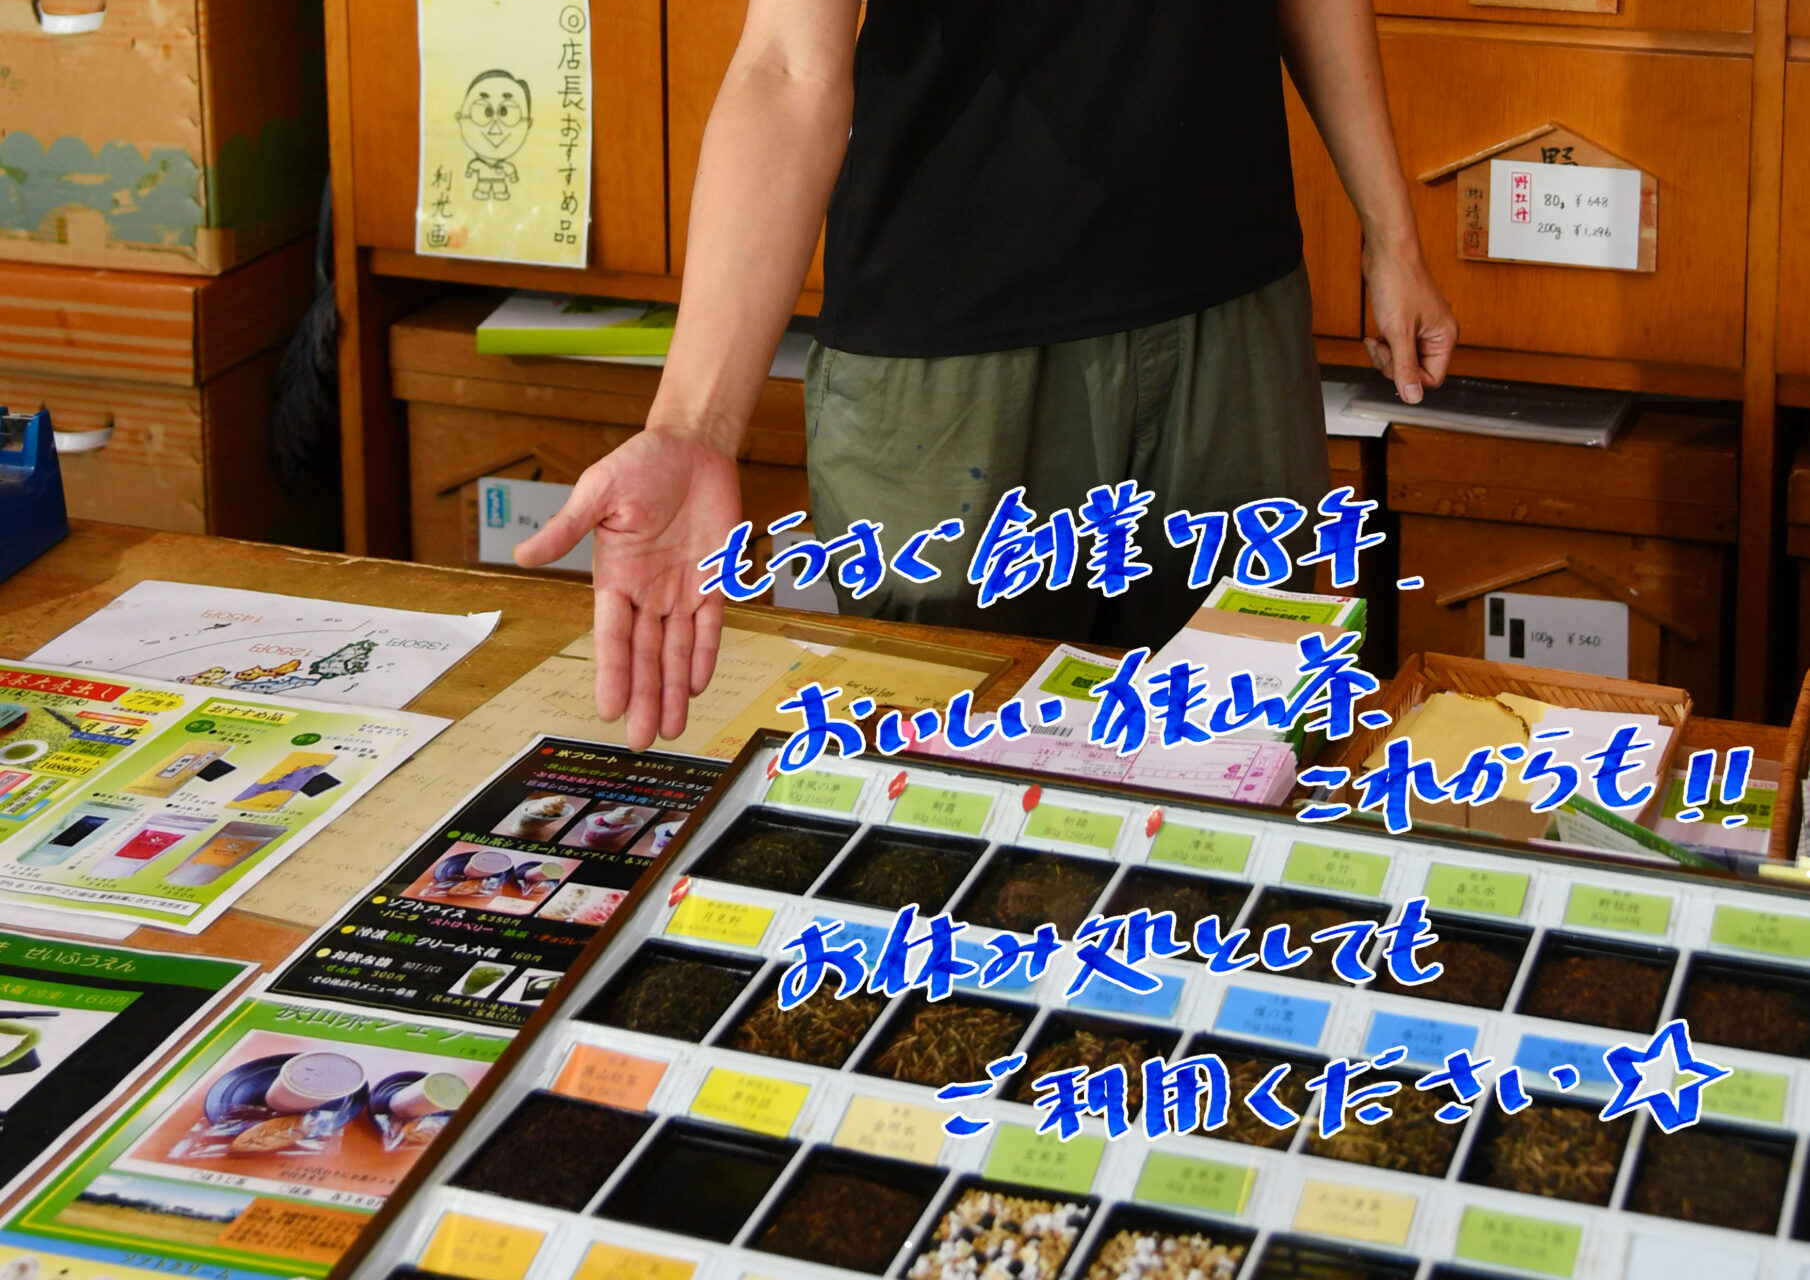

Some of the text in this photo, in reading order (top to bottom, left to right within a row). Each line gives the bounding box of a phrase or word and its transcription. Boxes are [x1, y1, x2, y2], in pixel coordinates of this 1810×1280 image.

[1514, 176, 1528, 221] 野牡丹
[207, 704, 285, 723] おすすめ品
[388, 898, 467, 920] ソフトアイス
